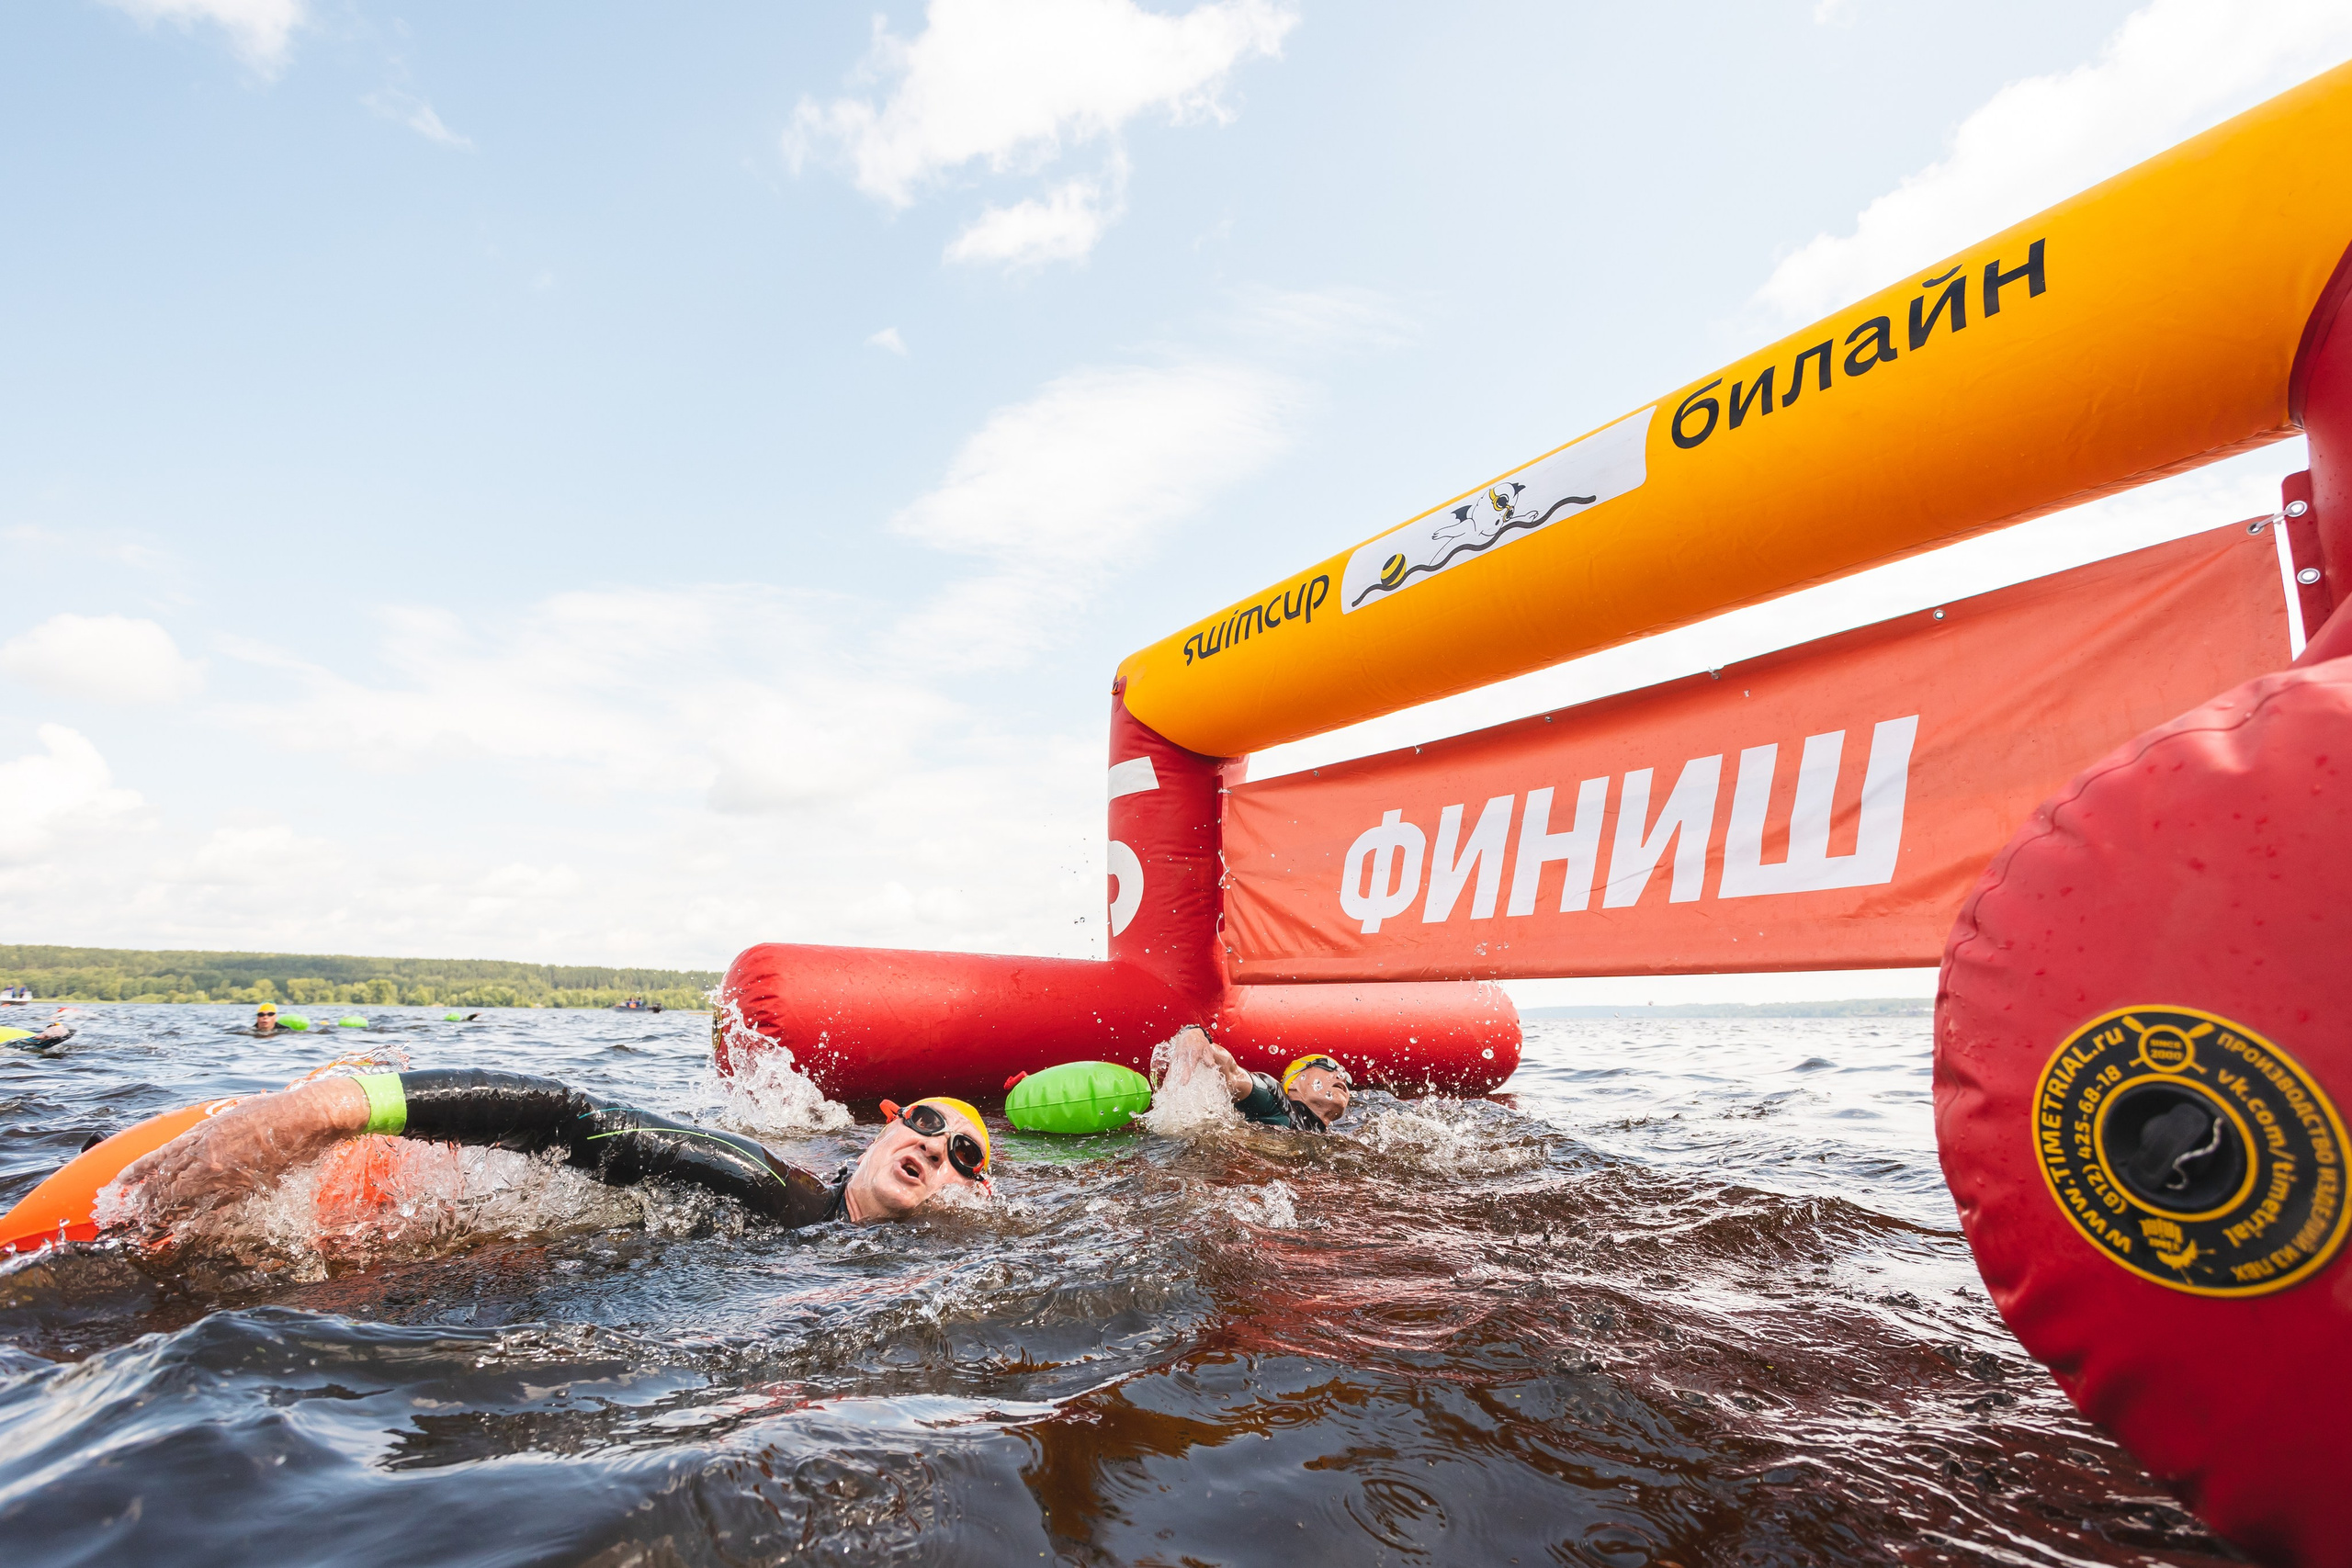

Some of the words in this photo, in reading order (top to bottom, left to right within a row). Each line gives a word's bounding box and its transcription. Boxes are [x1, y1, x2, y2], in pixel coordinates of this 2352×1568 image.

[1670, 237, 2047, 450] билайн
[1183, 574, 1330, 667] swimcup
[1340, 714, 1919, 933] ФИНИШ
[2150, 1048, 2183, 1061] 2000
[2216, 1032, 2337, 1165] ПРОИЗВОДСТВО
[2074, 1064, 2122, 1160] 425-68-18
[2217, 1067, 2298, 1248] vk.com/timetrial
[2082, 1163, 2128, 1214] (812)
